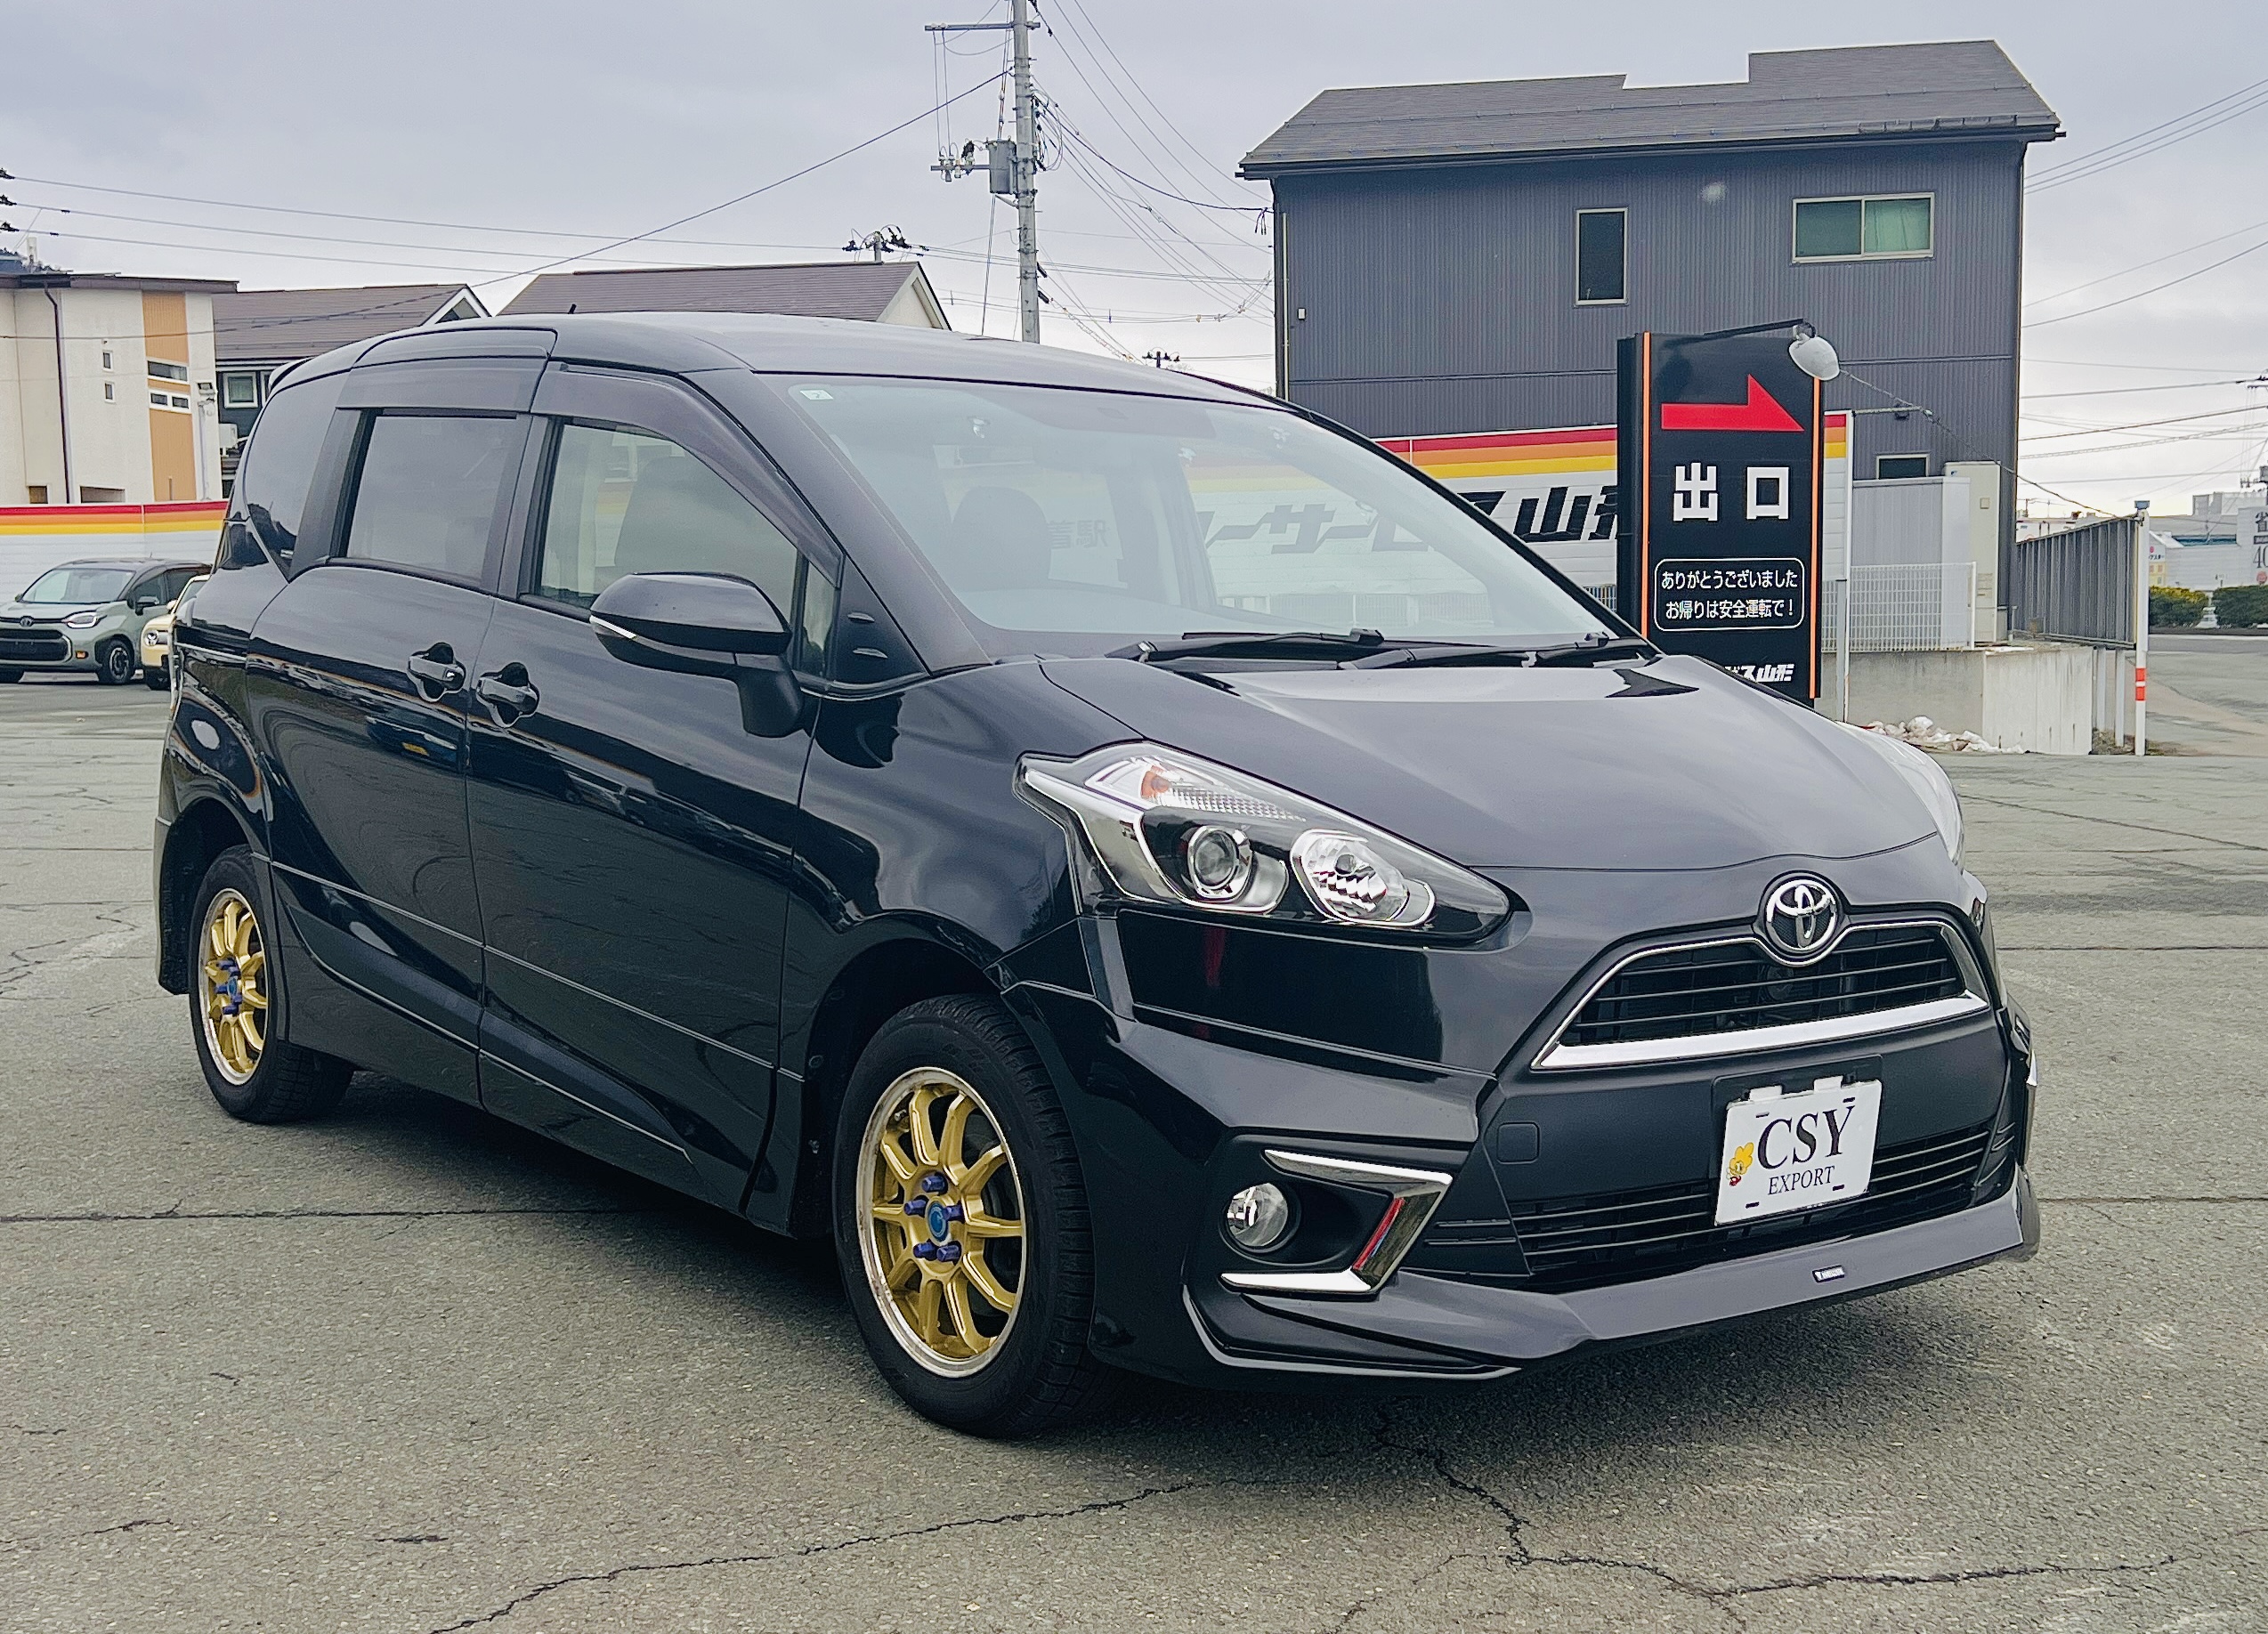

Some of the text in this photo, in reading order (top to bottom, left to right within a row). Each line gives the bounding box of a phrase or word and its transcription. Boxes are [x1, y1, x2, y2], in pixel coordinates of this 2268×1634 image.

[1673, 463, 1788, 521] 出口
[1662, 570, 1797, 589] ありがとうございました
[1757, 1105, 1855, 1170] CSY
[1768, 1166, 1835, 1195] EXPORT
